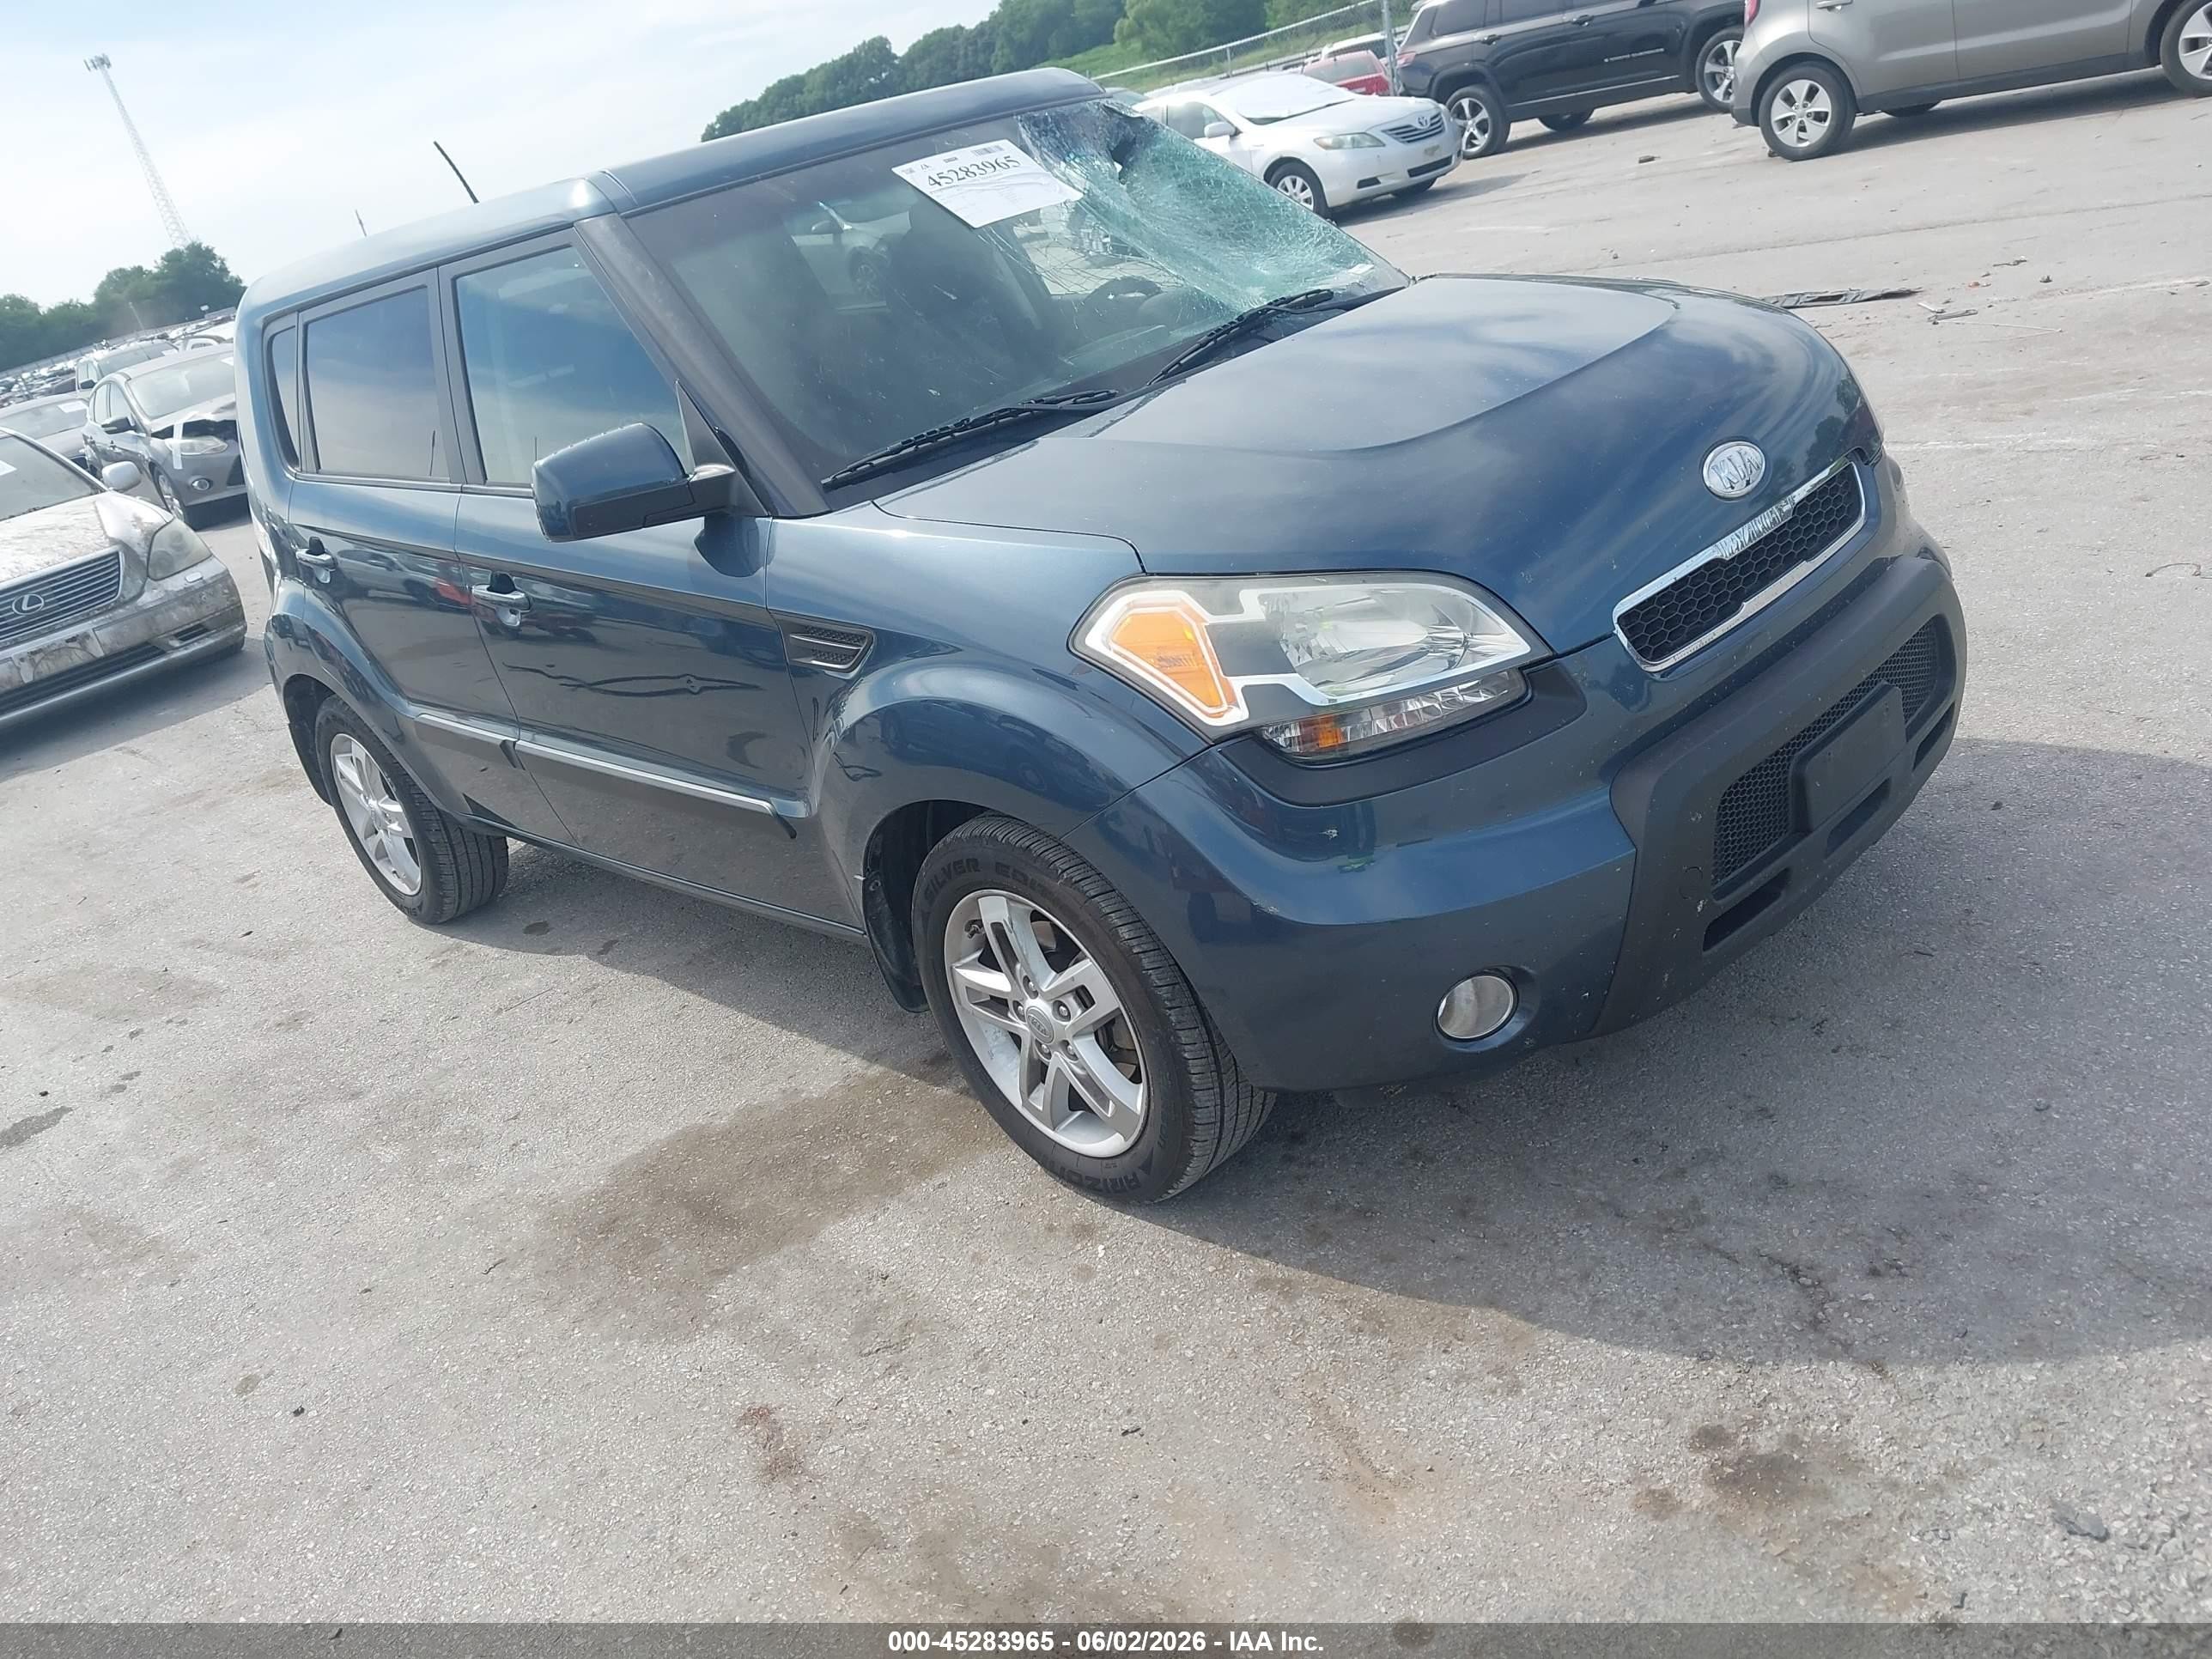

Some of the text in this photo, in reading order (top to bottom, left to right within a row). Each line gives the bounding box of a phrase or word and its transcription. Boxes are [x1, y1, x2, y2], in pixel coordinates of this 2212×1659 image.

[927, 155, 1021, 186] 45283965
[1711, 447, 1761, 490] KIA
[923, 857, 981, 901] SILVER
